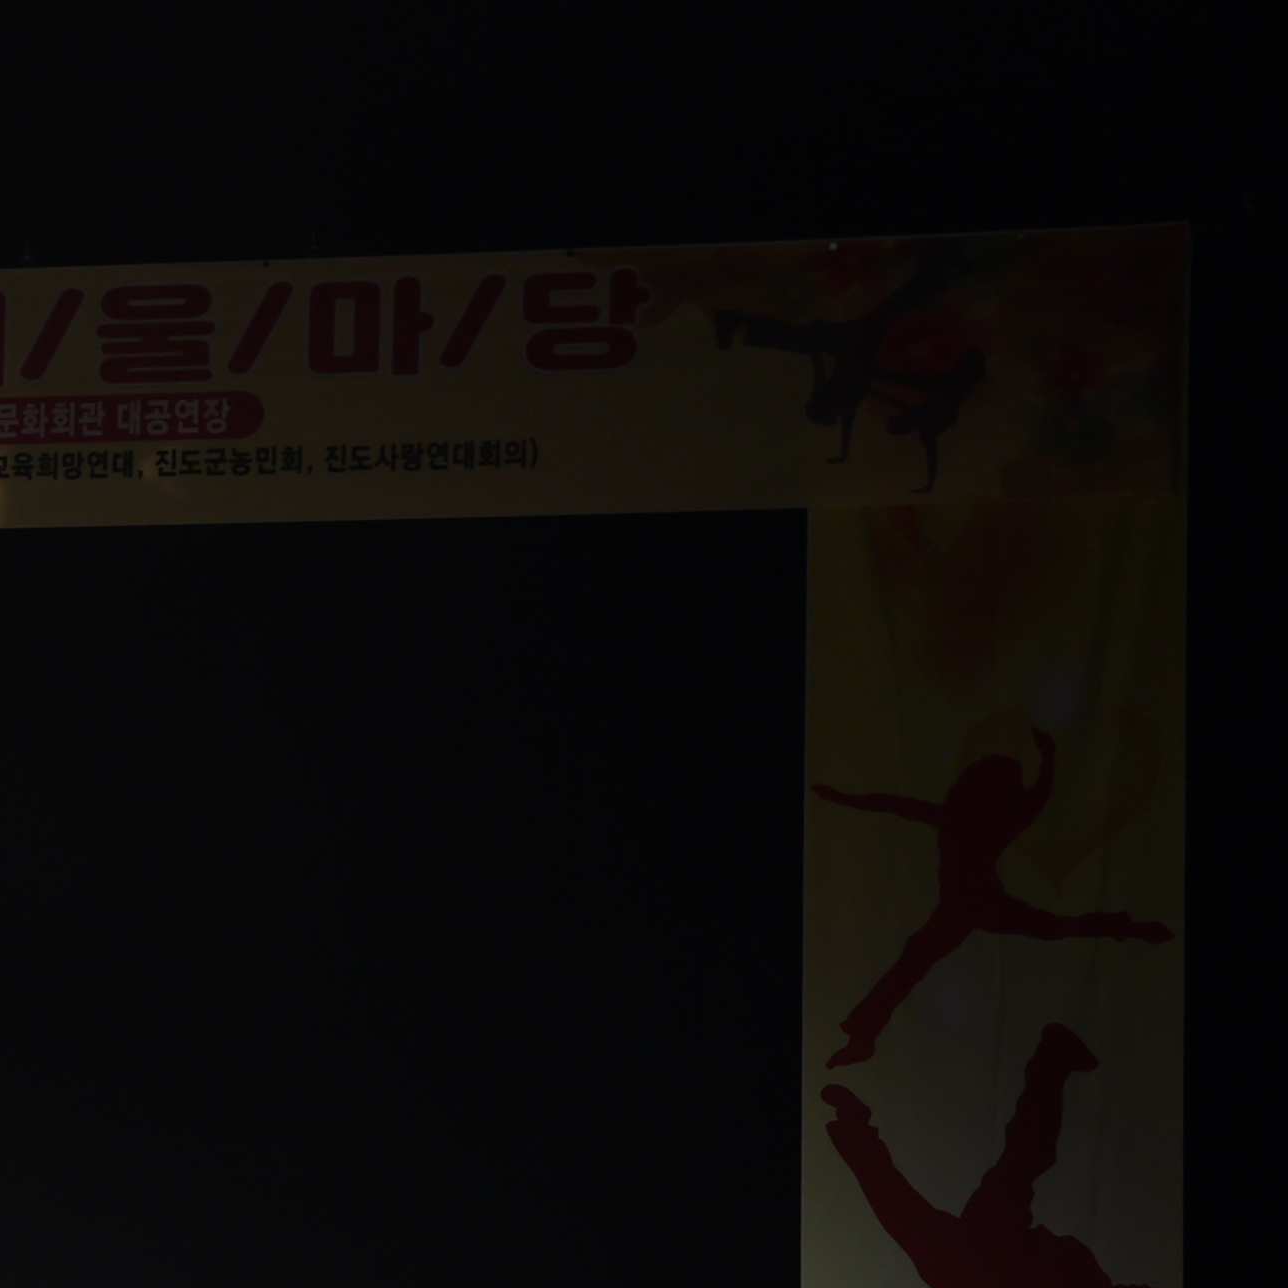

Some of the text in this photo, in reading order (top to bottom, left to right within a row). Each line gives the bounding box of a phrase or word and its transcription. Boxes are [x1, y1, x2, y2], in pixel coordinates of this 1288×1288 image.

[117, 397, 231, 435] 대공연장
[155, 444, 313, 476] 진도군농민회,
[325, 437, 540, 473] 진도사랑연대회의)
